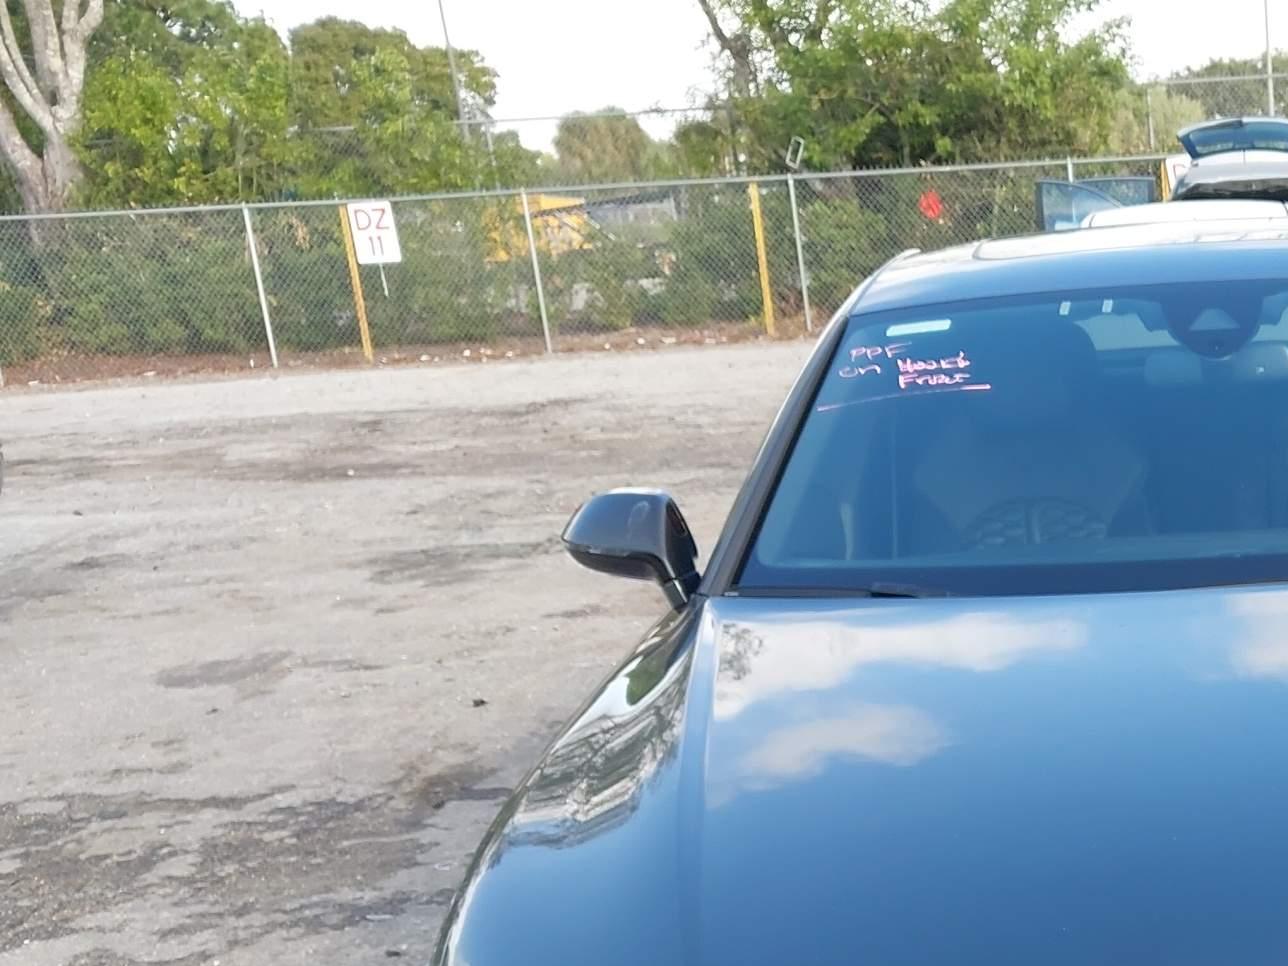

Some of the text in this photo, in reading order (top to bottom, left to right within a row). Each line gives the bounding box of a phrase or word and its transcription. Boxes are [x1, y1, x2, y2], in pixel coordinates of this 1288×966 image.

[353, 208, 390, 231] DZ
[368, 236, 385, 256] 11
[850, 341, 912, 361] PPF
